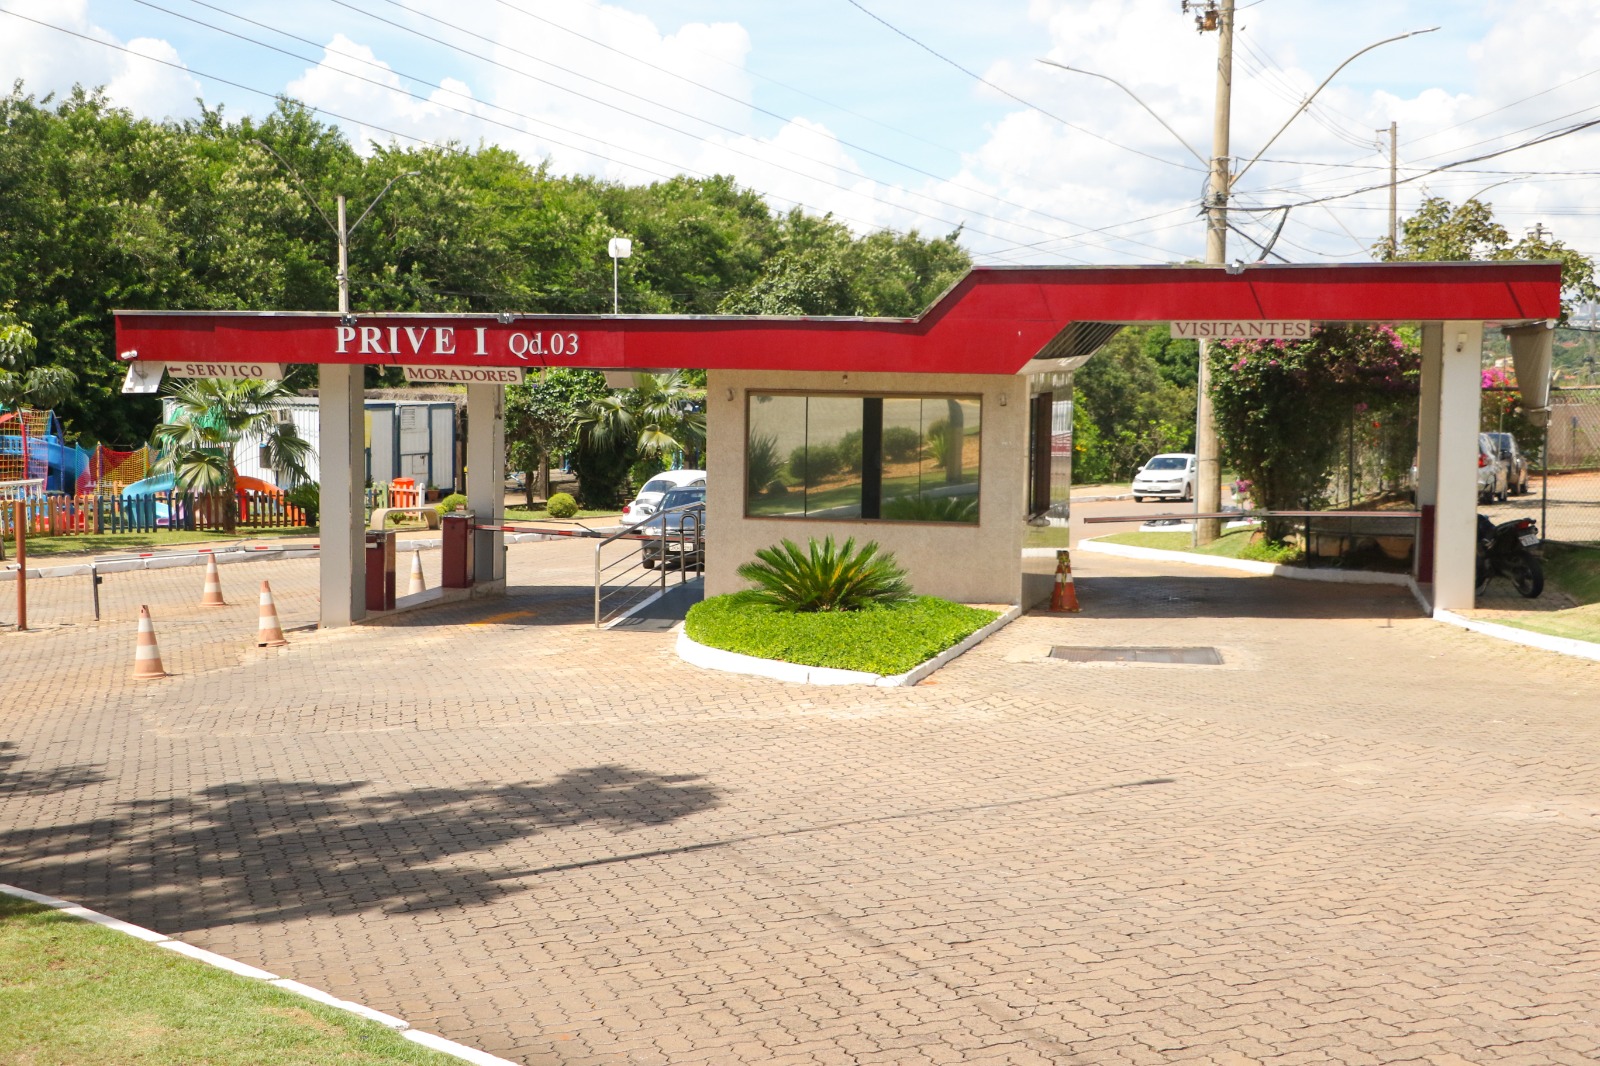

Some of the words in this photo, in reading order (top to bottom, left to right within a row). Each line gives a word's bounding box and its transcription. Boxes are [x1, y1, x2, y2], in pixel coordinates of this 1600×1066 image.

[1175, 322, 1306, 336] VISITANTES
[335, 326, 456, 355] PRIVE
[473, 327, 489, 356] I
[508, 332, 579, 360] Qd.03
[186, 364, 263, 378] SERVIÇO
[407, 367, 518, 382] MORADORES
